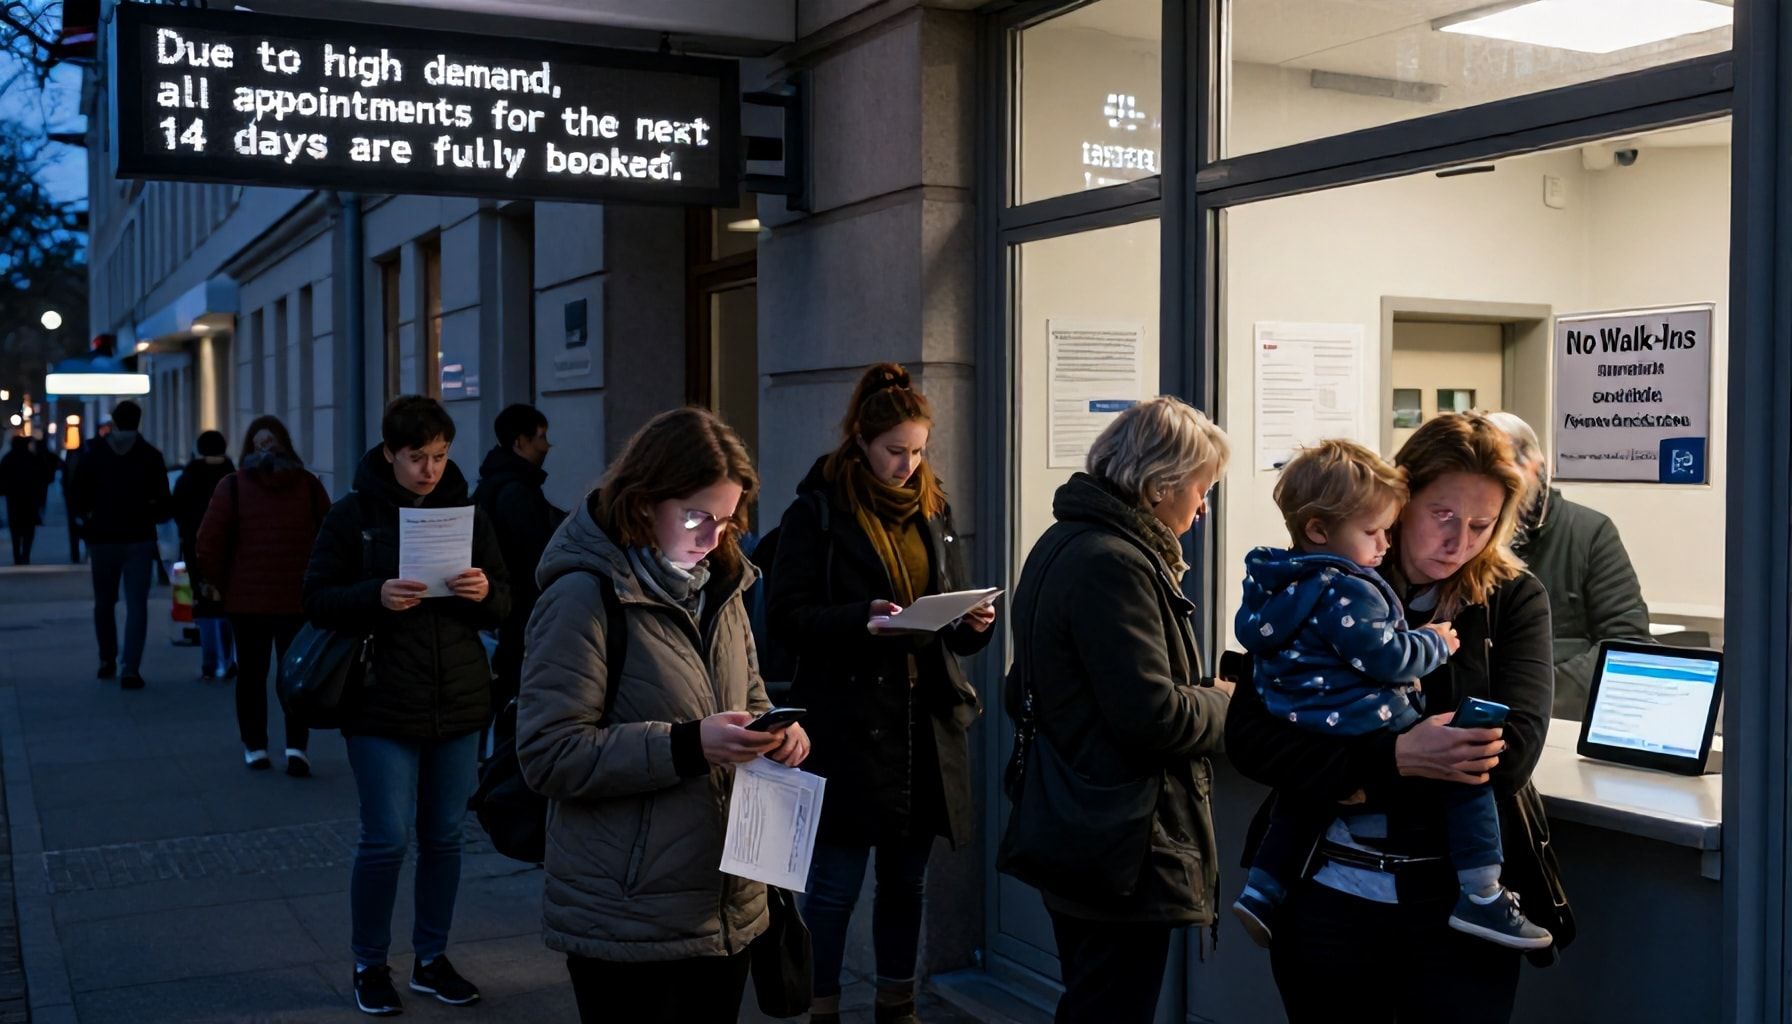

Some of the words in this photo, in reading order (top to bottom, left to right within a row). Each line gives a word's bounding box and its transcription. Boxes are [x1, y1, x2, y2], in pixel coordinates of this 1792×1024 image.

[157, 28, 234, 69] Due
[257, 41, 302, 75] to
[324, 44, 402, 88] high
[157, 75, 210, 110] all
[233, 87, 473, 127] appointments
[491, 99, 546, 133] for
[561, 106, 620, 139] the
[159, 115, 208, 152] 14
[233, 117, 329, 162] days
[349, 136, 413, 164] are
[433, 135, 526, 179] fully
[546, 142, 682, 182] booked.
[1566, 330, 1597, 355] No
[1600, 323, 1696, 353] Walk-Ins
